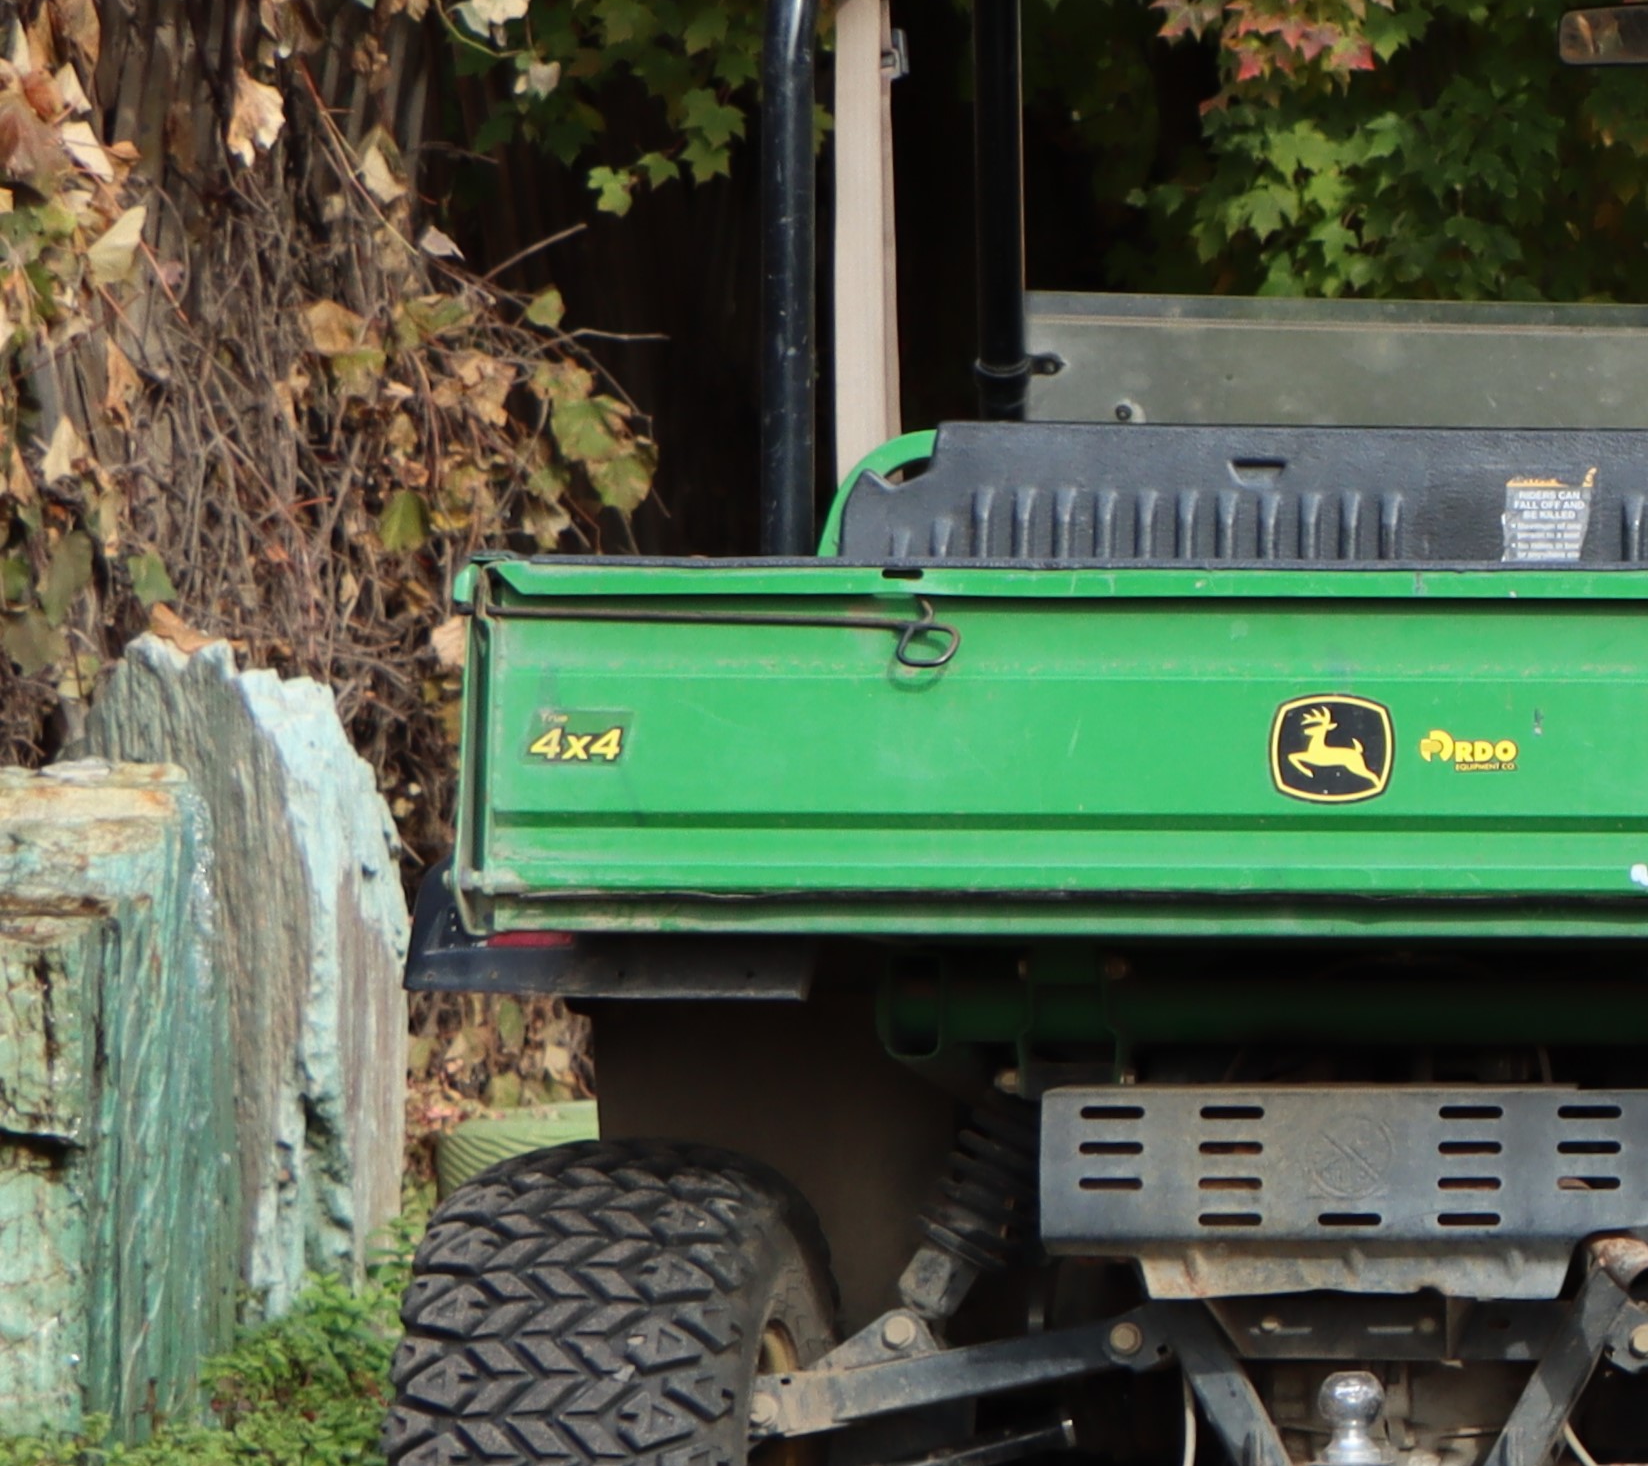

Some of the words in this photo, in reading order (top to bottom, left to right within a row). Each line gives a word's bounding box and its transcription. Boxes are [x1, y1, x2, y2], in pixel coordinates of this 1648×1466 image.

[1519, 490, 1556, 500] RIDERS
[1558, 491, 1580, 500] CAN
[1514, 501, 1539, 510] FALL
[1541, 501, 1561, 510] OFF
[1563, 501, 1585, 510] AND
[1523, 511, 1538, 520] BE
[1540, 511, 1576, 520] KILLED
[530, 727, 622, 761] 4x4
